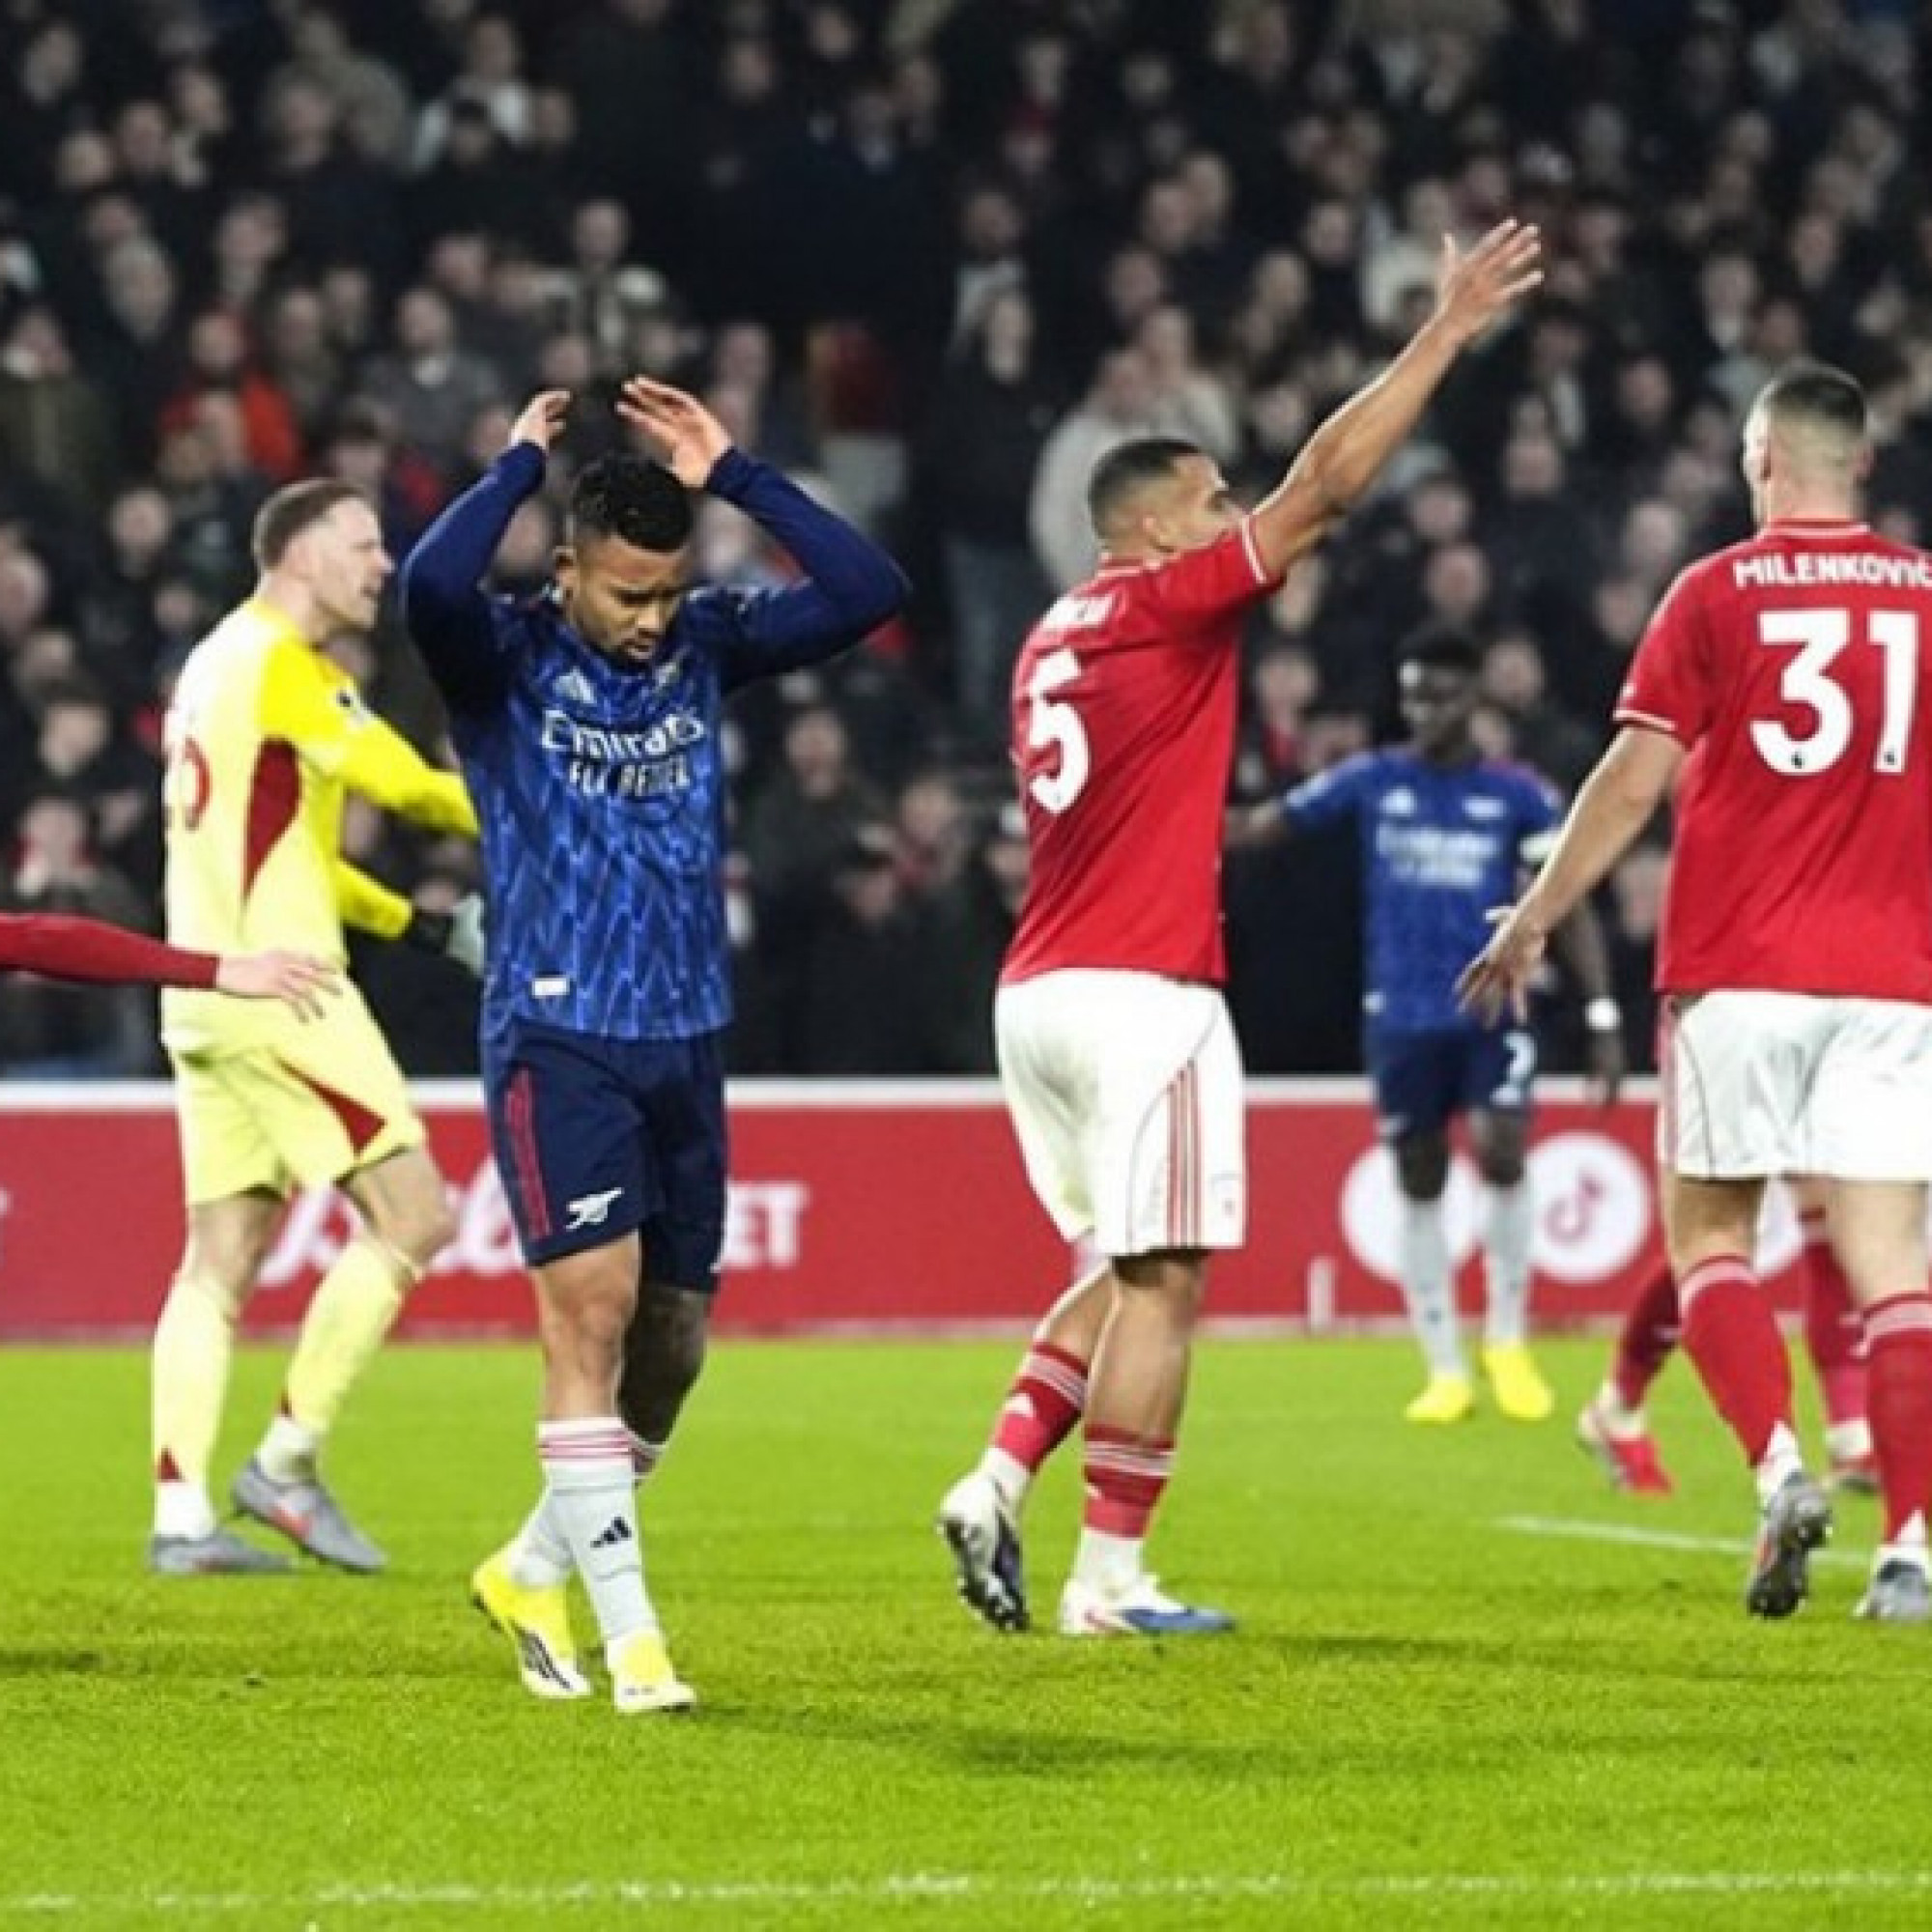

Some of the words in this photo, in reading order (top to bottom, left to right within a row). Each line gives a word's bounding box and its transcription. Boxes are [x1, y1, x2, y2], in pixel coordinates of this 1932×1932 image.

[1028, 645, 1090, 815] 5
[1748, 608, 1919, 776] 31
[723, 1180, 811, 1267] ET
